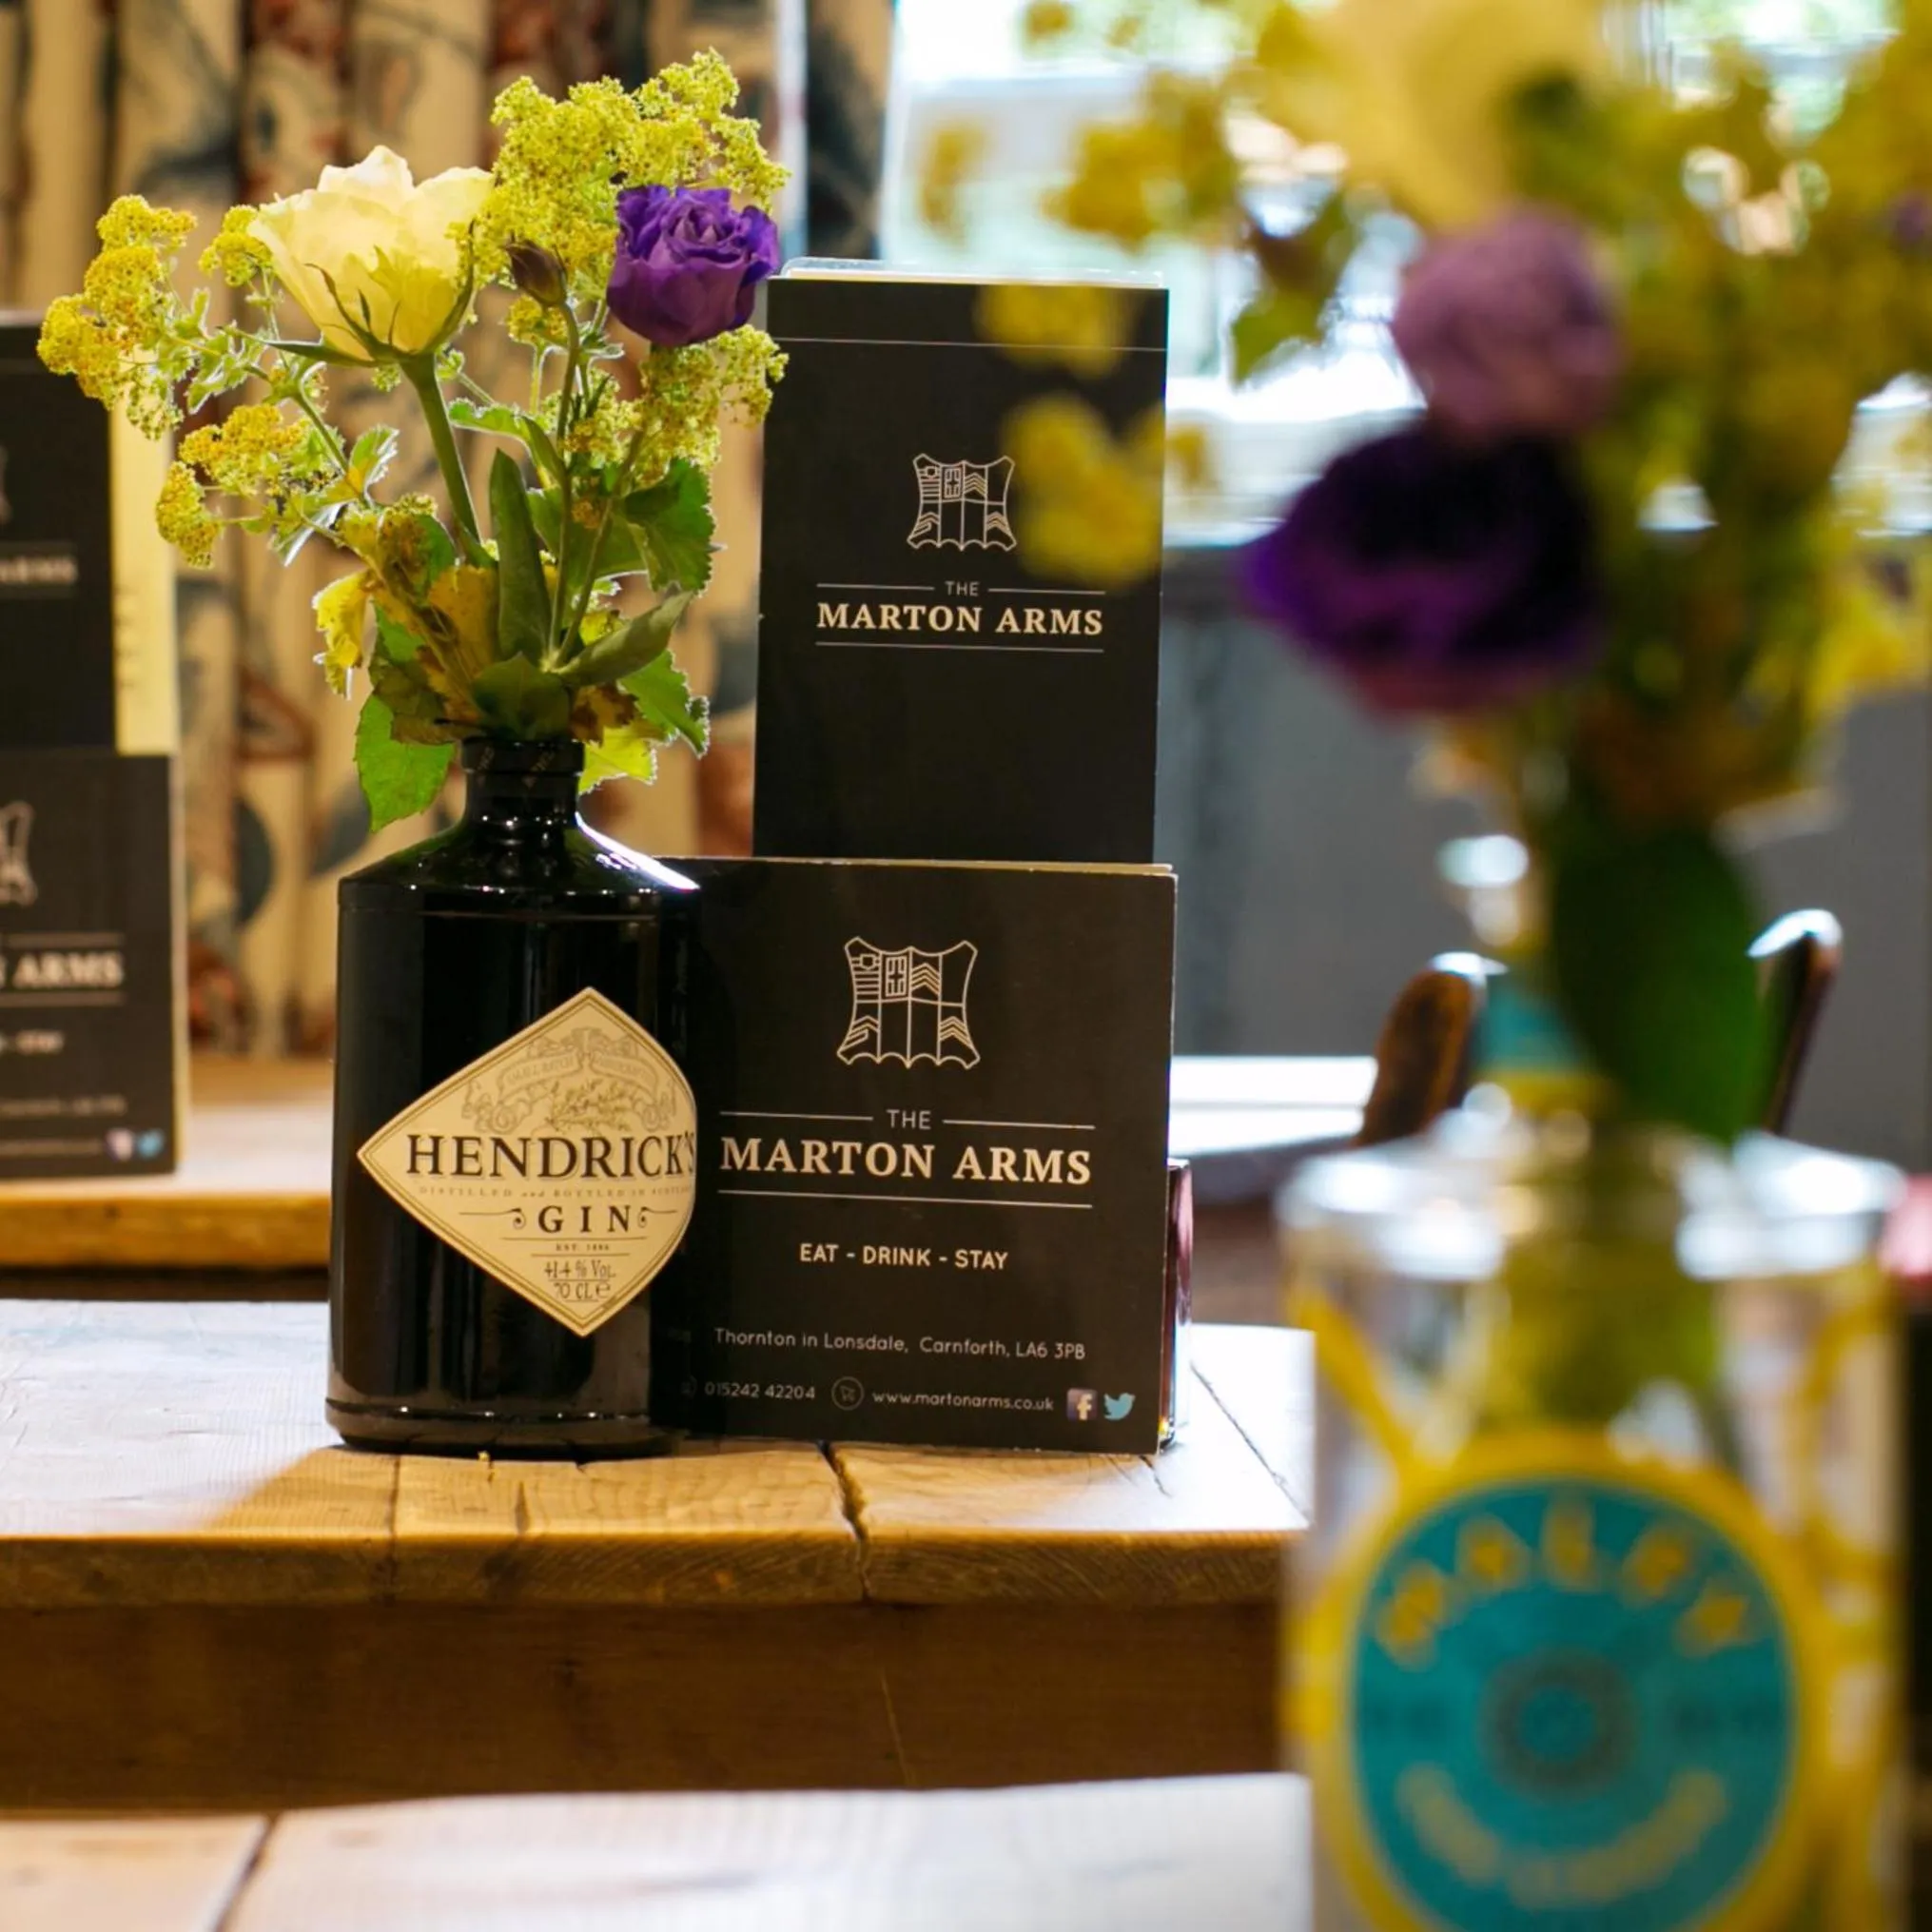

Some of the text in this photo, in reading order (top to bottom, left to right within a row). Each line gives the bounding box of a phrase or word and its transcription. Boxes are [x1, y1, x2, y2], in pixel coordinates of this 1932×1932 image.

[945, 581, 979, 597] THE
[816, 603, 1103, 635] MARTON ARMS
[887, 1109, 931, 1130] THE
[406, 1130, 694, 1179] HENDRICK'S
[720, 1137, 1091, 1185] MARTON ARMS
[537, 1205, 632, 1234] GIN
[800, 1243, 839, 1262] EAT
[863, 1245, 931, 1266] DRINK
[955, 1249, 1008, 1270] STAY
[554, 1282, 571, 1299] 70
[714, 1328, 1086, 1360] Thornton in Lonsdale, Carnforth, LA6 3PB
[705, 1382, 760, 1398] 015242
[765, 1383, 816, 1400] 42204
[872, 1390, 1055, 1412] www.martonarms.co.uk
